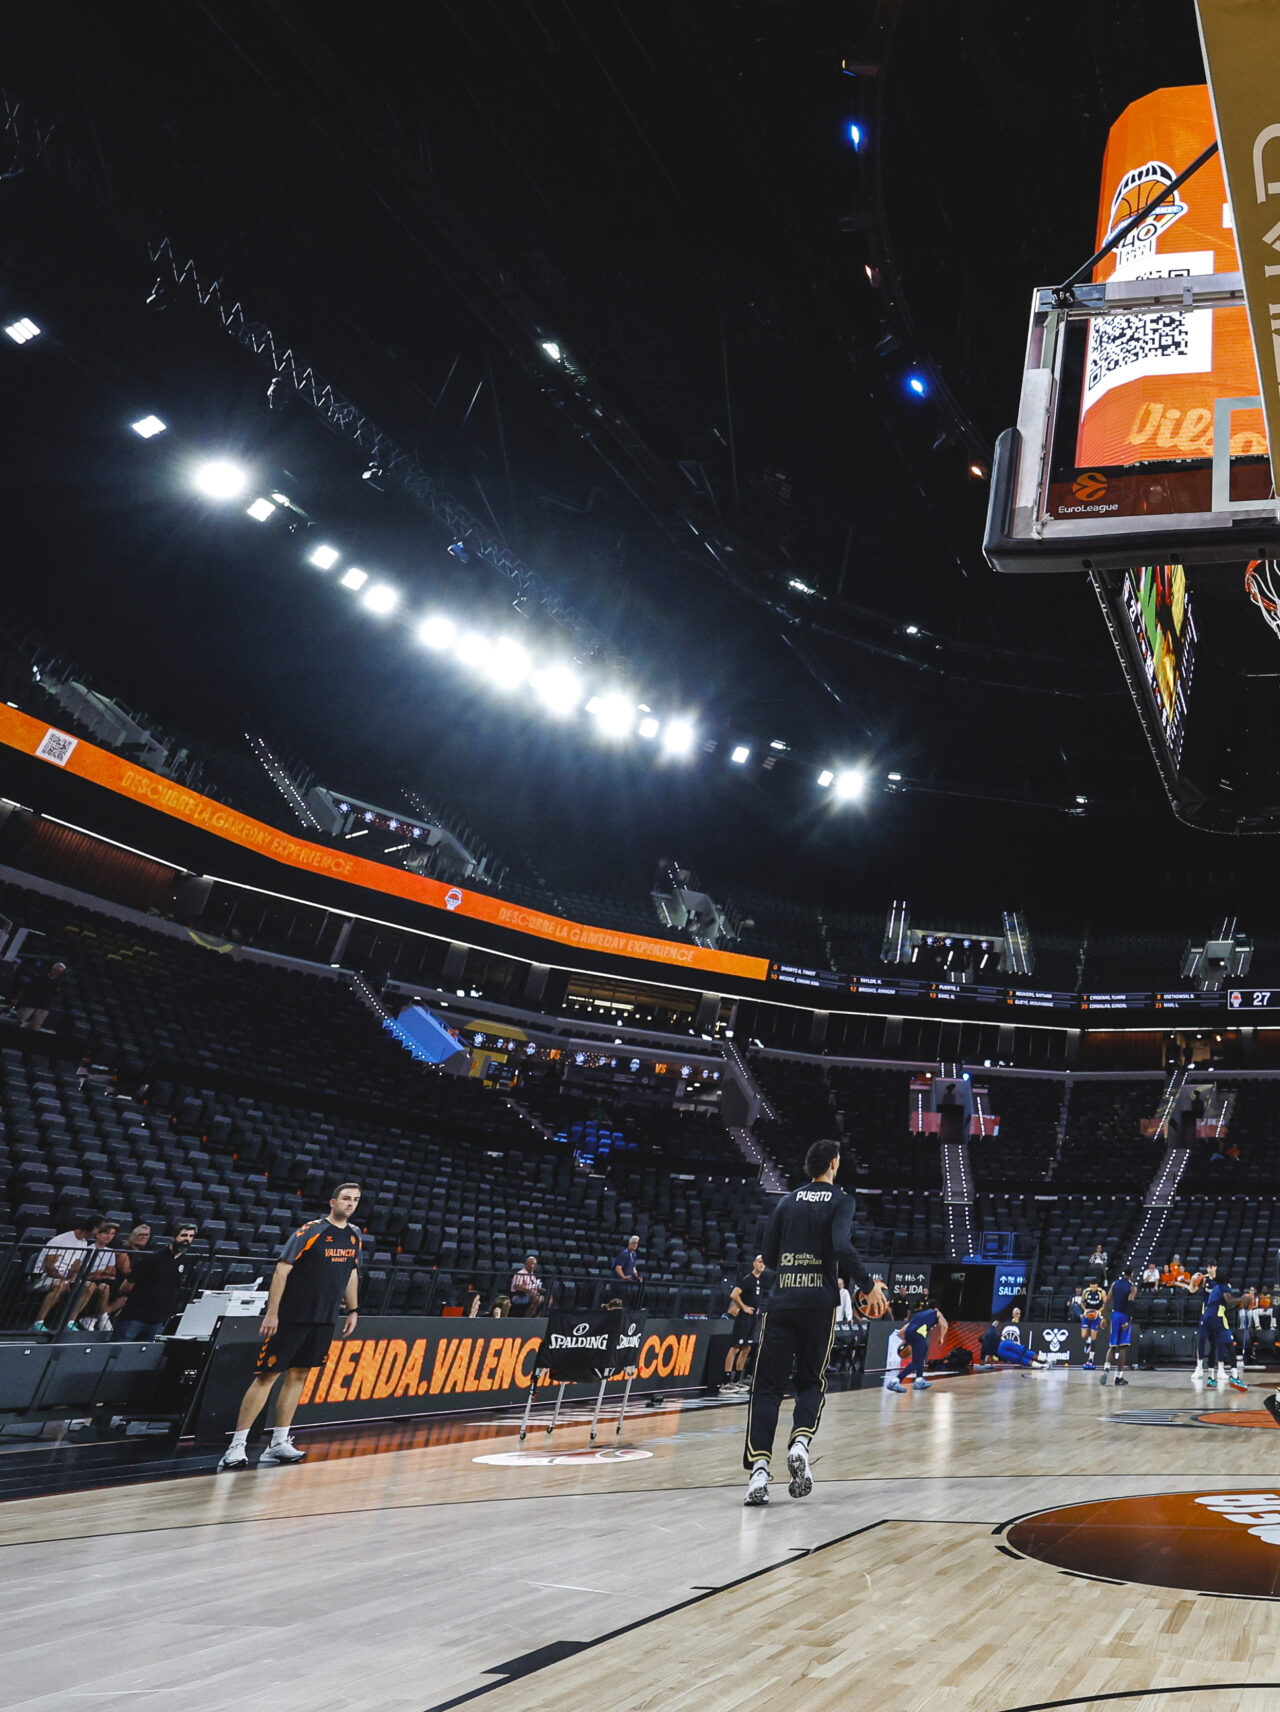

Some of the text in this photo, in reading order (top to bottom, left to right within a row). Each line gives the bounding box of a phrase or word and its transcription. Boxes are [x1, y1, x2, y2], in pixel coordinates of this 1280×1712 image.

[1058, 502, 1119, 515] EuroLeague
[122, 771, 354, 874] DESCUBRE LA GAMEDAY EXPERIENCE
[498, 907, 696, 962] DESCUBRE LA GAMEDAY EXPERIENCE
[1253, 992, 1271, 1006] 27
[550, 1048, 562, 1061] VS
[655, 1063, 668, 1075] VS
[796, 1190, 832, 1202] PUERTO
[325, 1248, 355, 1257] VALENCIA
[794, 1258, 822, 1266] popular
[780, 1272, 823, 1289] VALENCIA
[998, 1286, 1027, 1296] SALIDA
[549, 1334, 609, 1350] SPALDING
[1039, 1350, 1071, 1361] hummel
